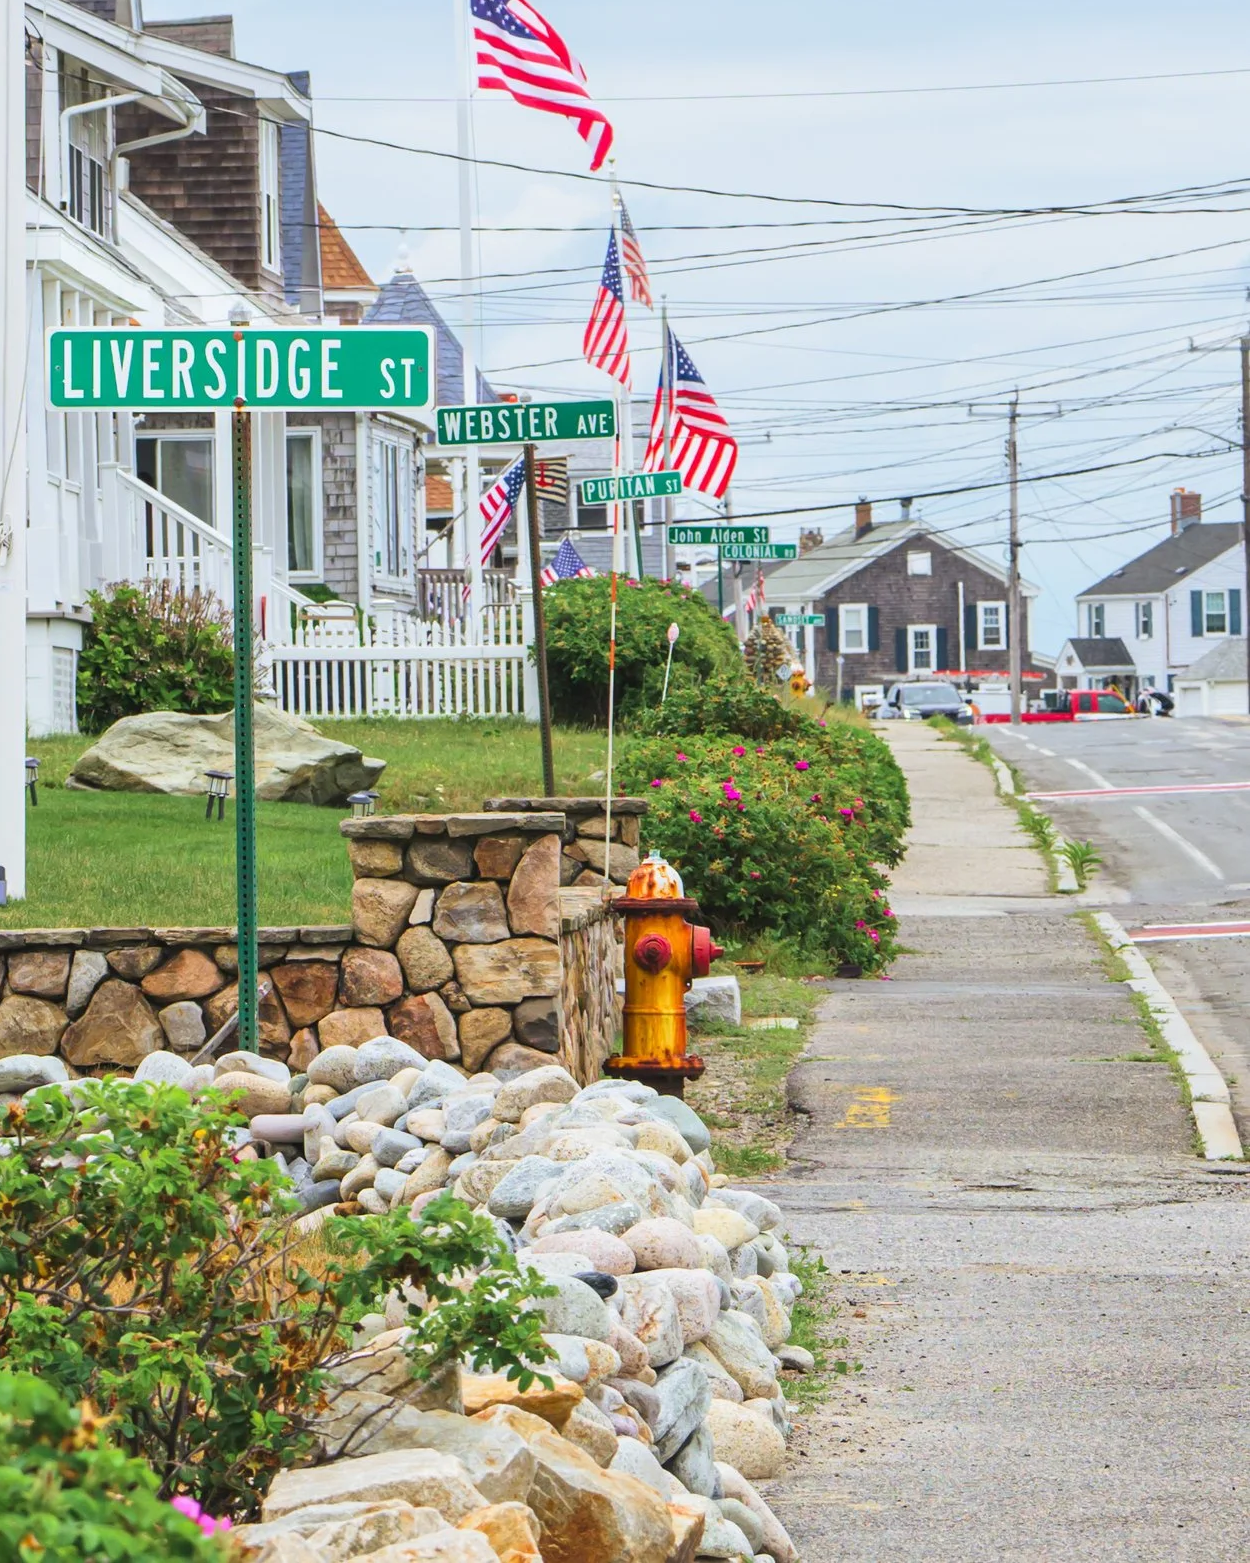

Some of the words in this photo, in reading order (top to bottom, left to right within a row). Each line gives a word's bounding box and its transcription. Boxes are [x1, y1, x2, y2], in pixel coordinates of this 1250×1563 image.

[63, 338, 343, 399] LIVERSIDGE
[380, 357, 416, 399] ST
[442, 407, 559, 441] WEBSTER
[577, 414, 610, 435] AVE
[586, 476, 656, 501] PURITAN
[665, 479, 679, 493] ST
[671, 528, 702, 543] John
[710, 528, 745, 543] Alden
[753, 528, 767, 543] St
[724, 545, 778, 558] COLONIAL
